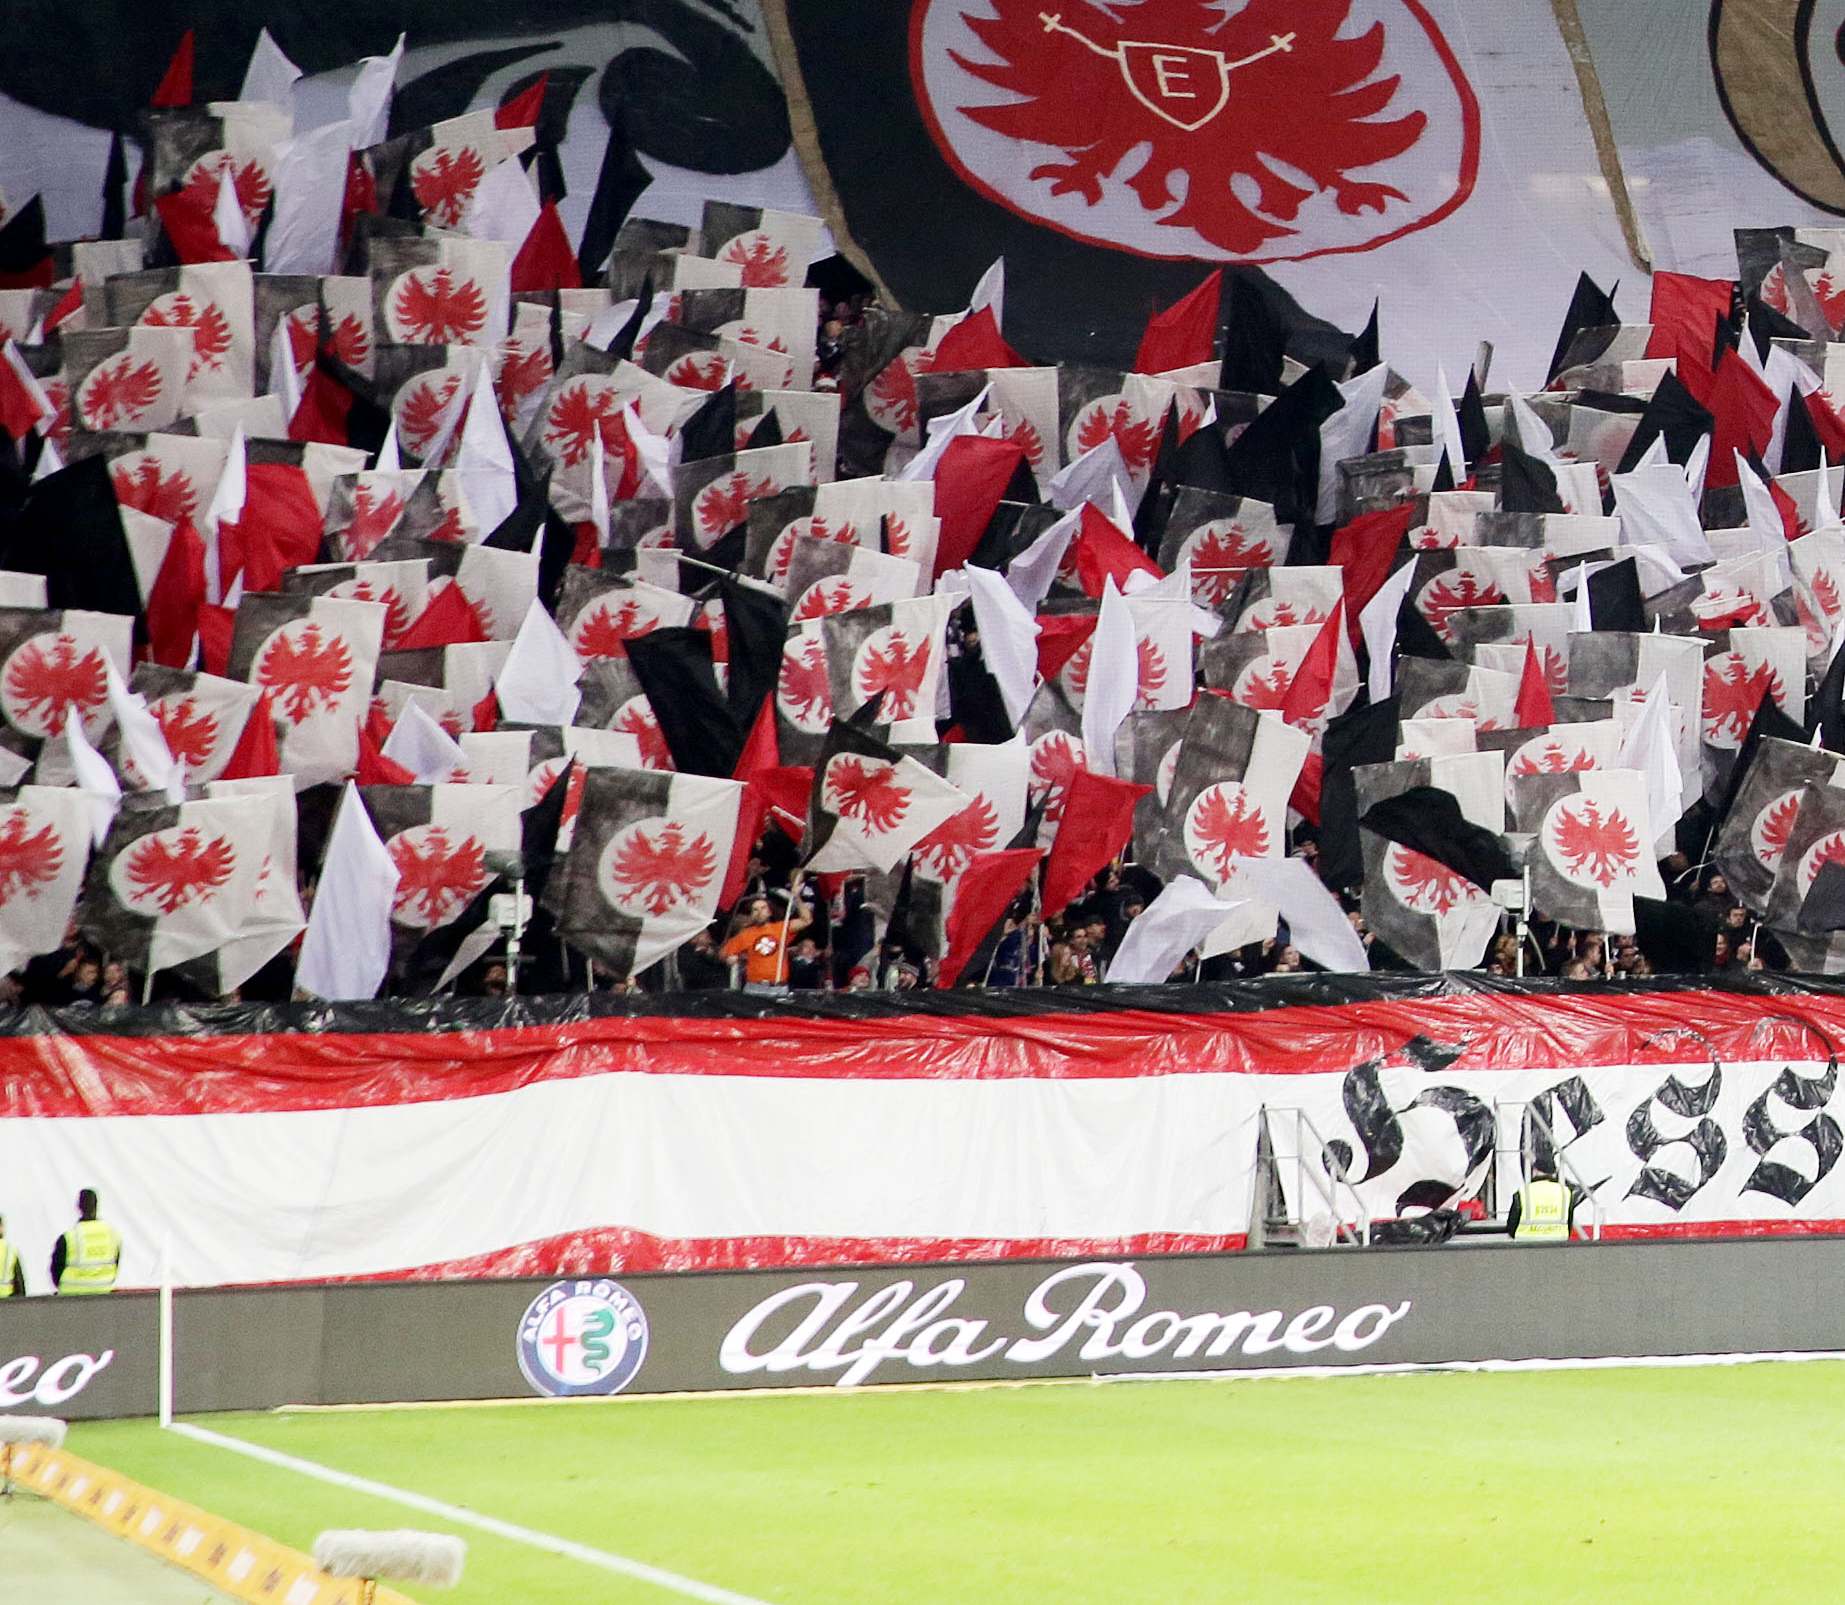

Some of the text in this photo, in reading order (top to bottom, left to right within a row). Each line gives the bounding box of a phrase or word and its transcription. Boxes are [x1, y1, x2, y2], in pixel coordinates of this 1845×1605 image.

[1152, 54, 1197, 98] E
[523, 1280, 642, 1344] ALFA ROMEO
[719, 1261, 1411, 1387] Alfa Romeo
